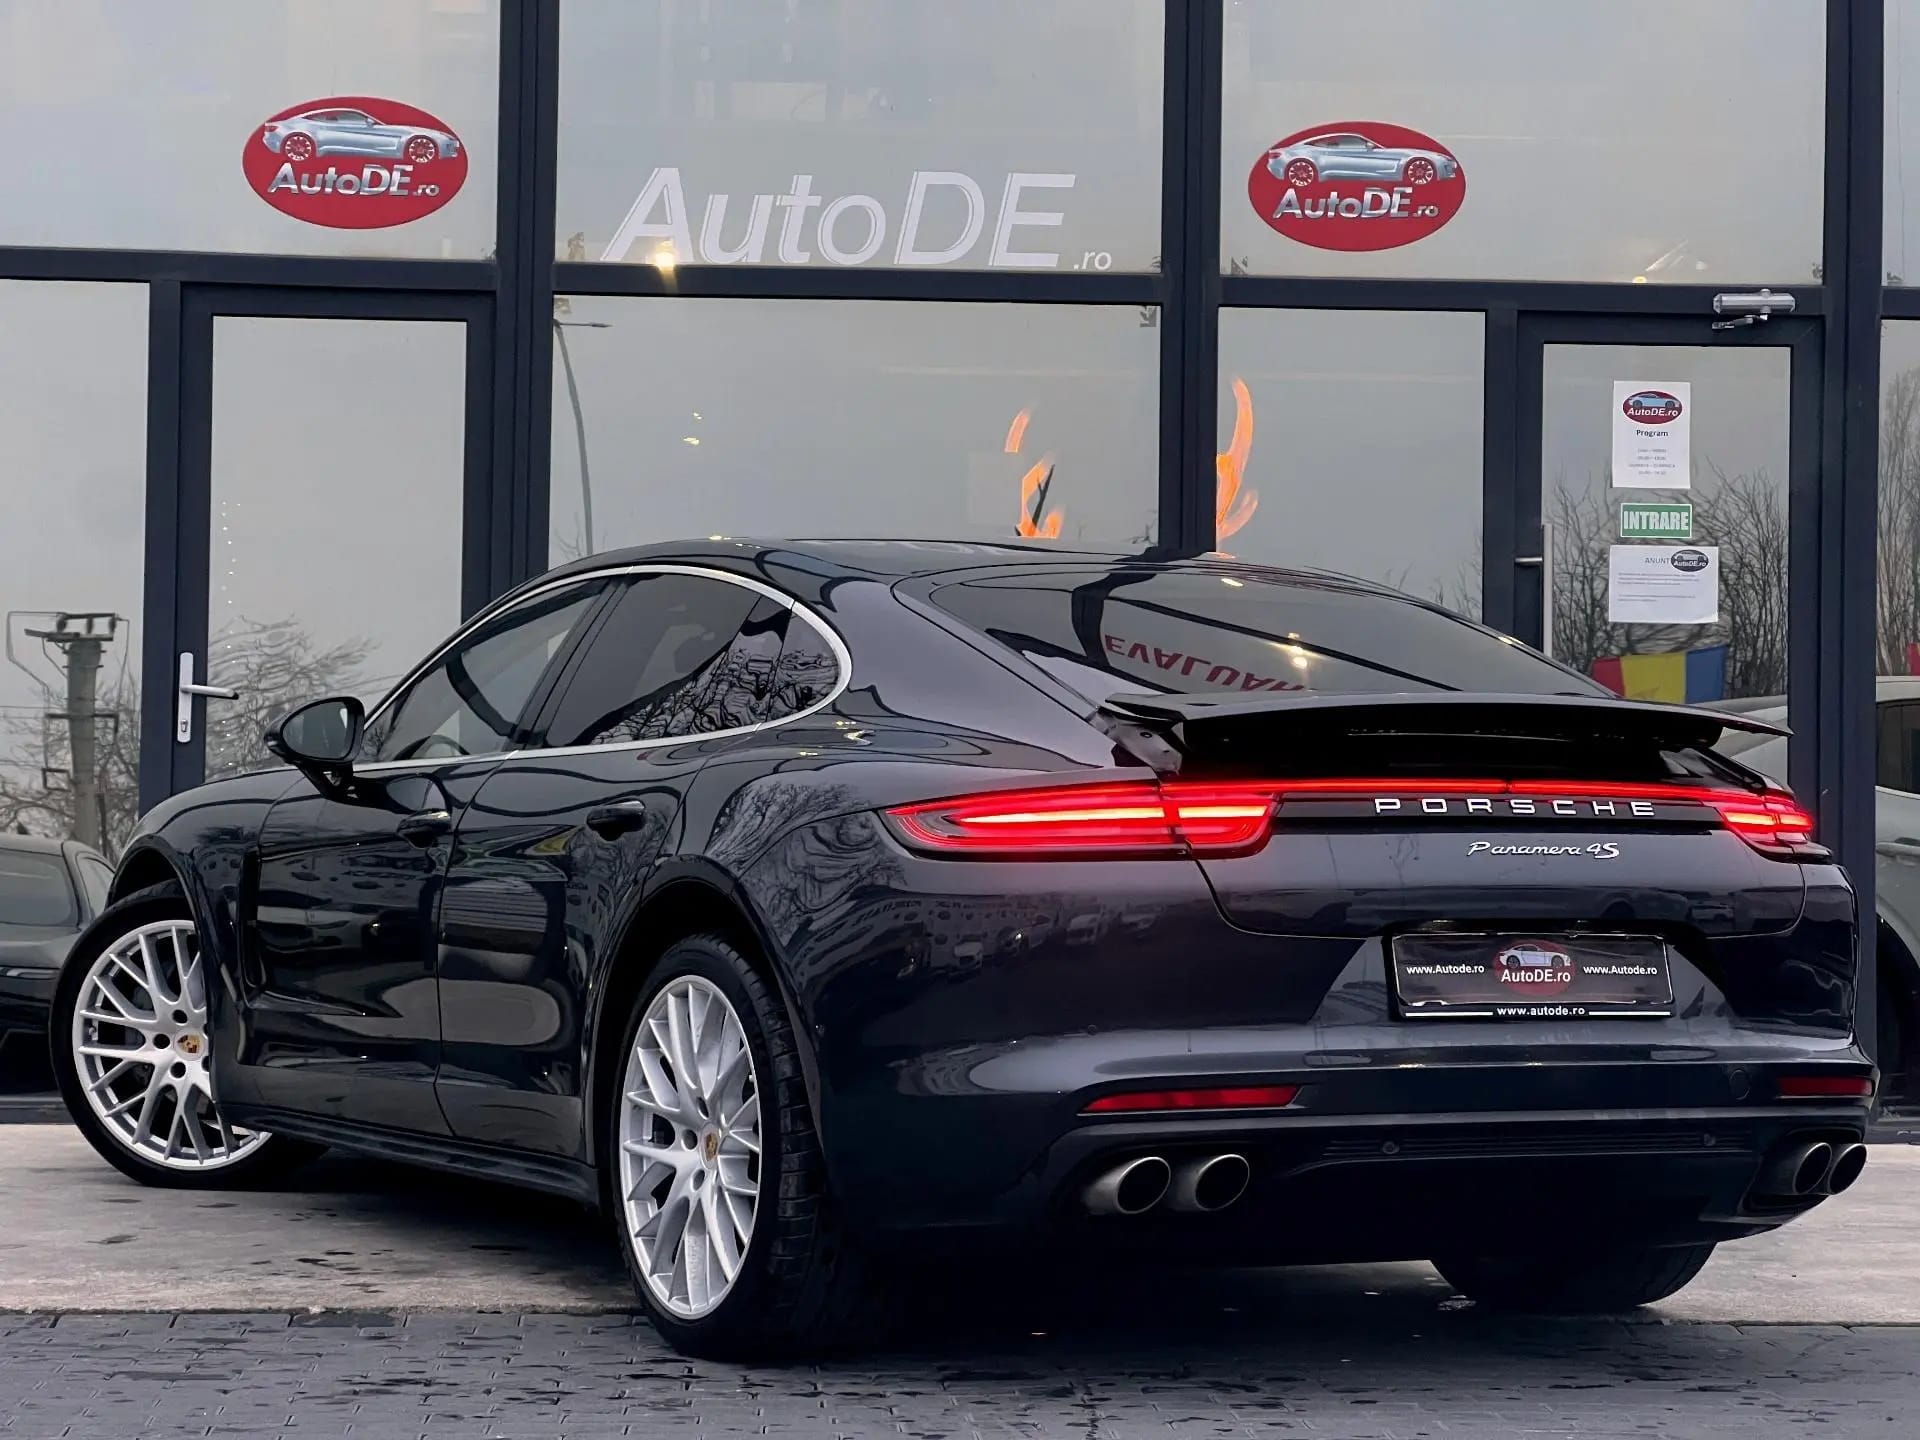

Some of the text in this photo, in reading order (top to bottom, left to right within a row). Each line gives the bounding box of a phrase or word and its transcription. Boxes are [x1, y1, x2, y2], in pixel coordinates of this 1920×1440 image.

[1636, 429, 1669, 438] Program
[1623, 510, 1689, 531] INTRARE
[1374, 798, 1655, 816] PORSCHE
[1467, 841, 1620, 859] Panamera 4S
[1406, 963, 1485, 975] www.Autode.ro
[1500, 968, 1572, 983] AutoDE.ro
[1583, 964, 1658, 975] www.Autode.ro
[1496, 1005, 1586, 1017] www.autode.ro
